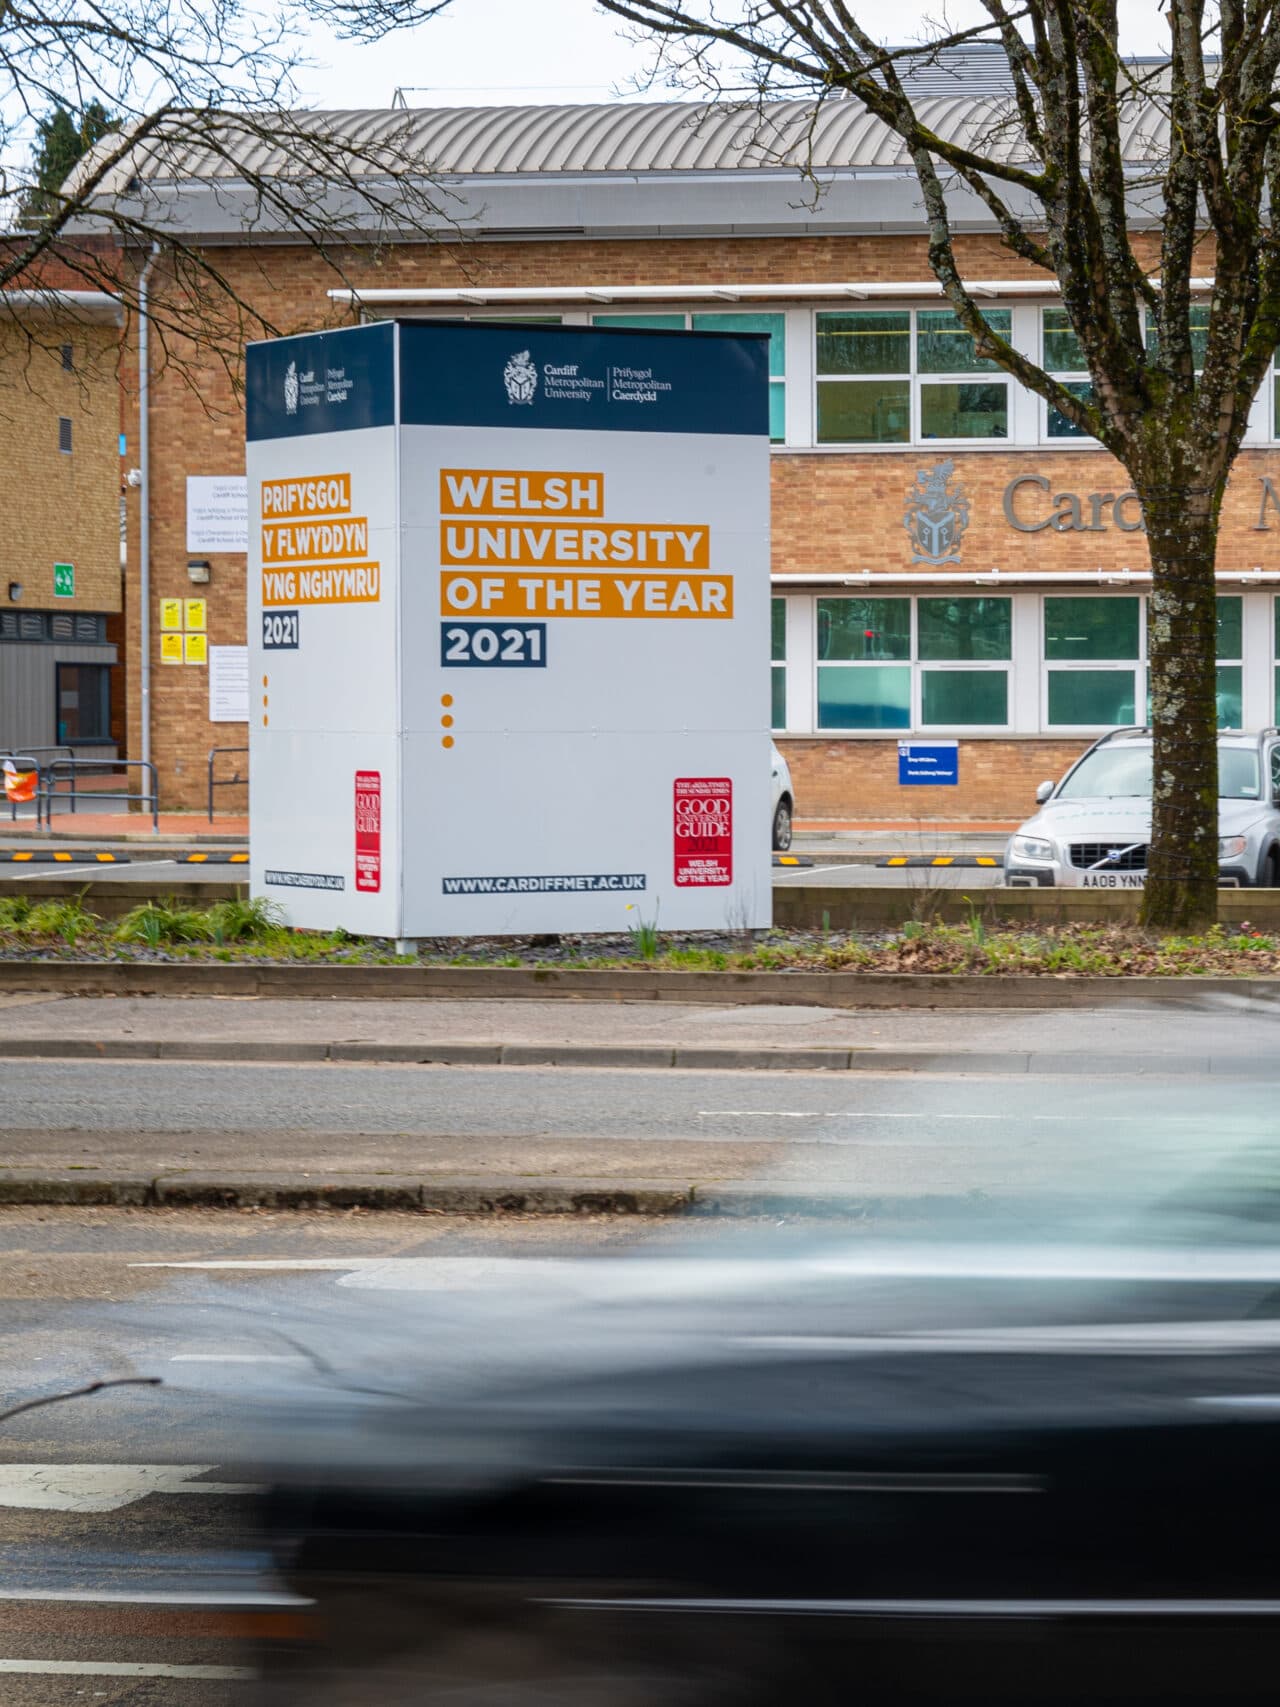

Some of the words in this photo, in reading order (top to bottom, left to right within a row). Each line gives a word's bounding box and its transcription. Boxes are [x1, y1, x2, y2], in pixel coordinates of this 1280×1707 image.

[544, 364, 579, 376] Cardiff
[613, 367, 652, 380] Prifysgol
[544, 377, 604, 389] Metropolitan
[613, 378, 672, 391] Metropolitan
[544, 388, 592, 401] University
[612, 390, 657, 403] Caerdydd
[263, 480, 349, 513] PRIFYSGOL
[446, 475, 598, 511] WELSH
[263, 529, 274, 558] Y
[277, 523, 366, 557] FLWYDDYN
[446, 526, 703, 562] UNIVERSITY
[263, 571, 296, 600] YNG
[299, 567, 379, 599] NGHYMRU
[446, 577, 505, 610] OF
[518, 579, 602, 611] THE
[614, 579, 727, 612] YEAR
[264, 615, 298, 644] 2021
[446, 628, 541, 661] 2021
[676, 798, 730, 815] GOOD
[676, 821, 730, 838] GUIDE
[678, 866, 728, 876] UNIVERSITY
[688, 860, 718, 868] WELSH
[445, 876, 645, 893] WWW.CARDIFFMET.AC.UK
[1082, 874, 1117, 888] AA08
